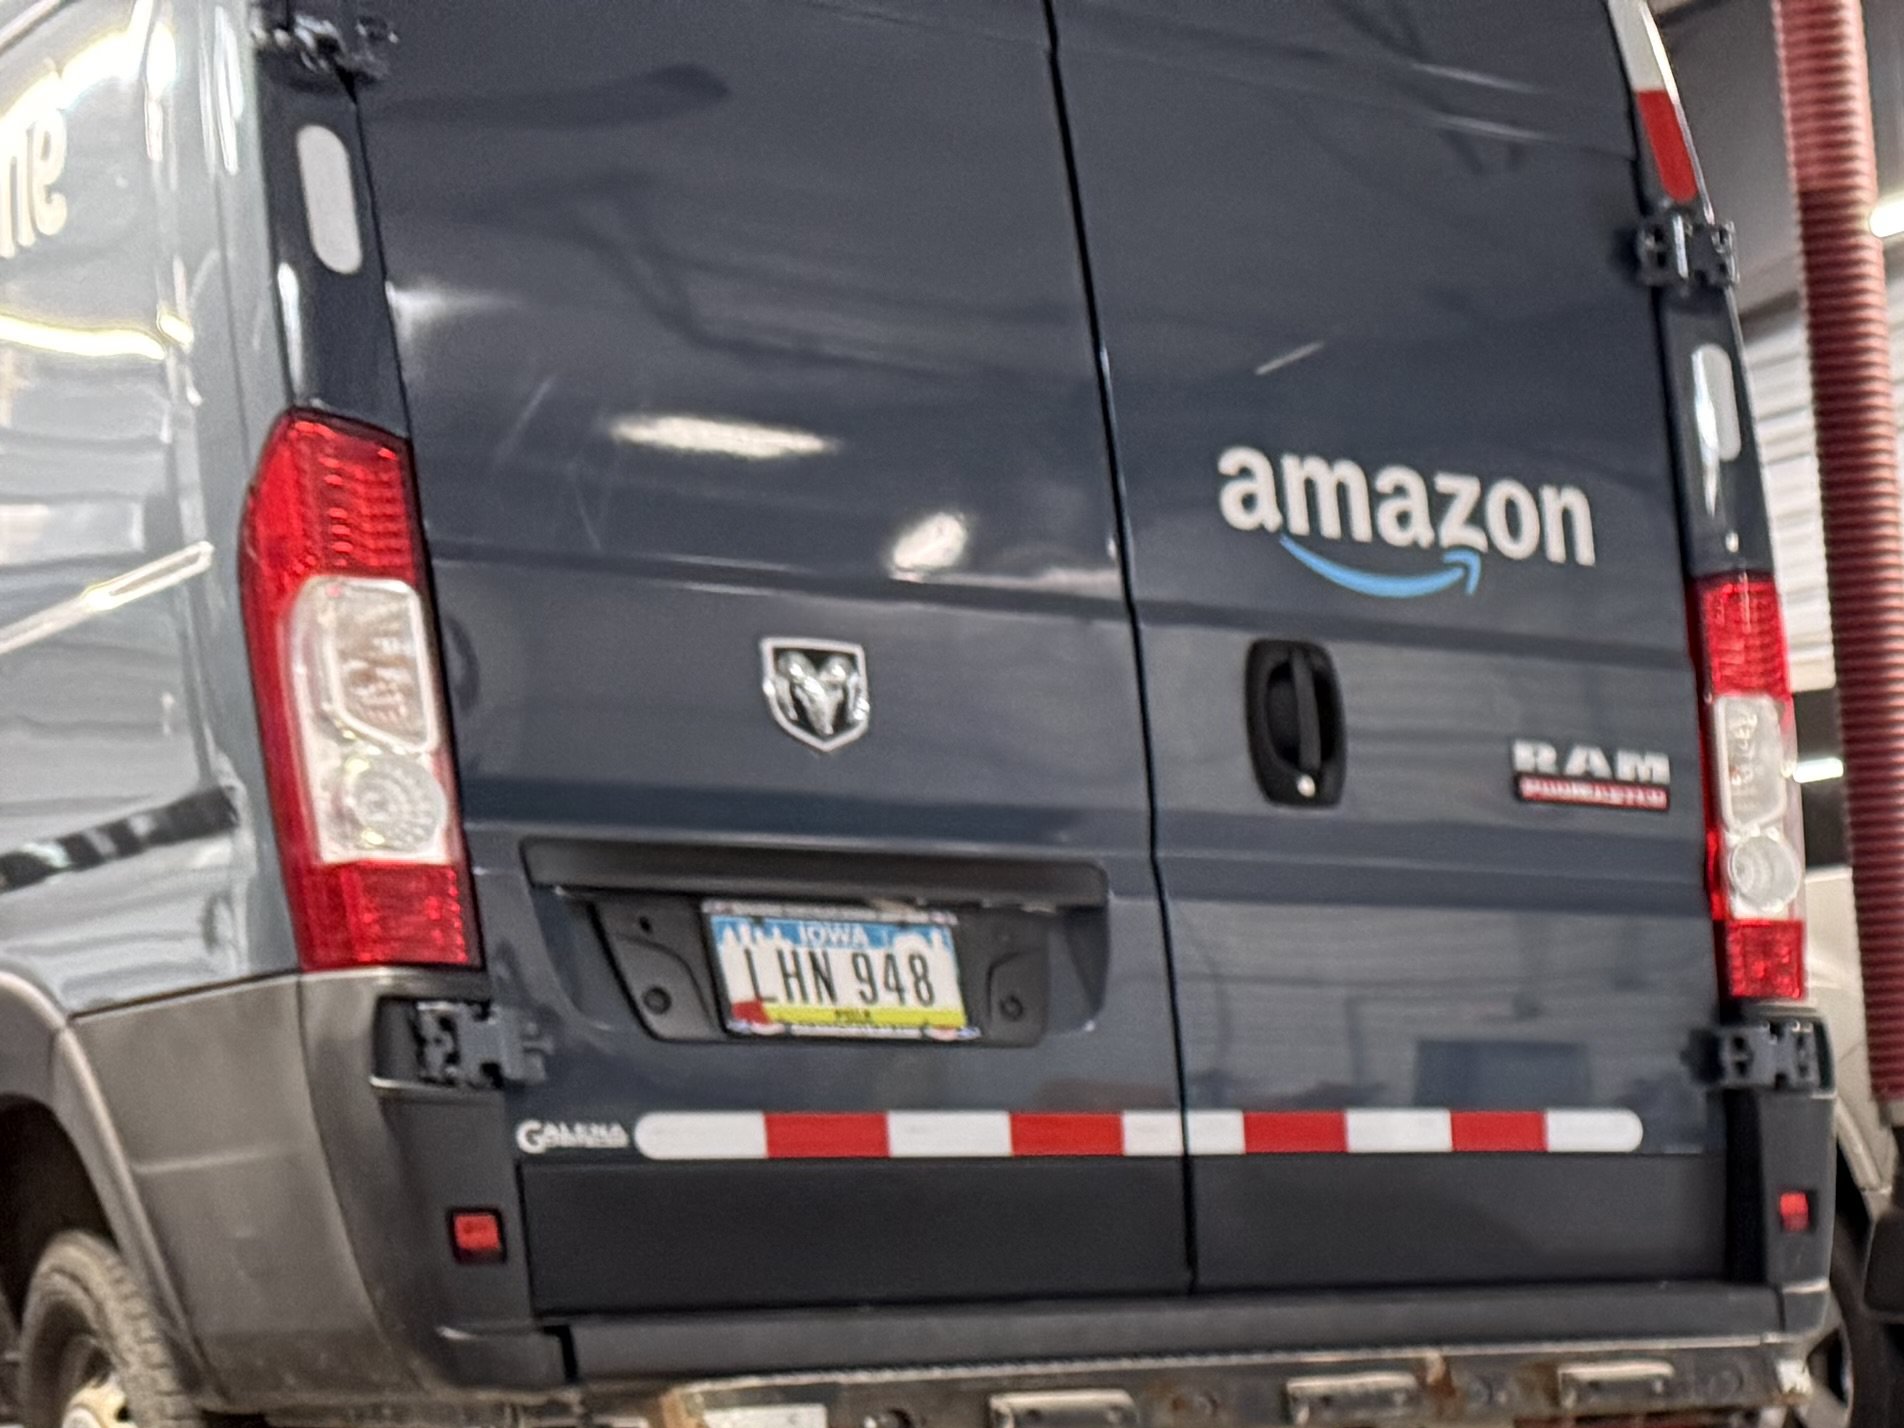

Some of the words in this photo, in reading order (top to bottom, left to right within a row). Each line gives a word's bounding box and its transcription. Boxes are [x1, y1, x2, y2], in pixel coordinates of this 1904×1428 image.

[1217, 445, 1597, 567] amazon
[1513, 739, 1671, 785] RAM
[799, 920, 869, 949] IOWA
[851, 951, 936, 1008] 948
